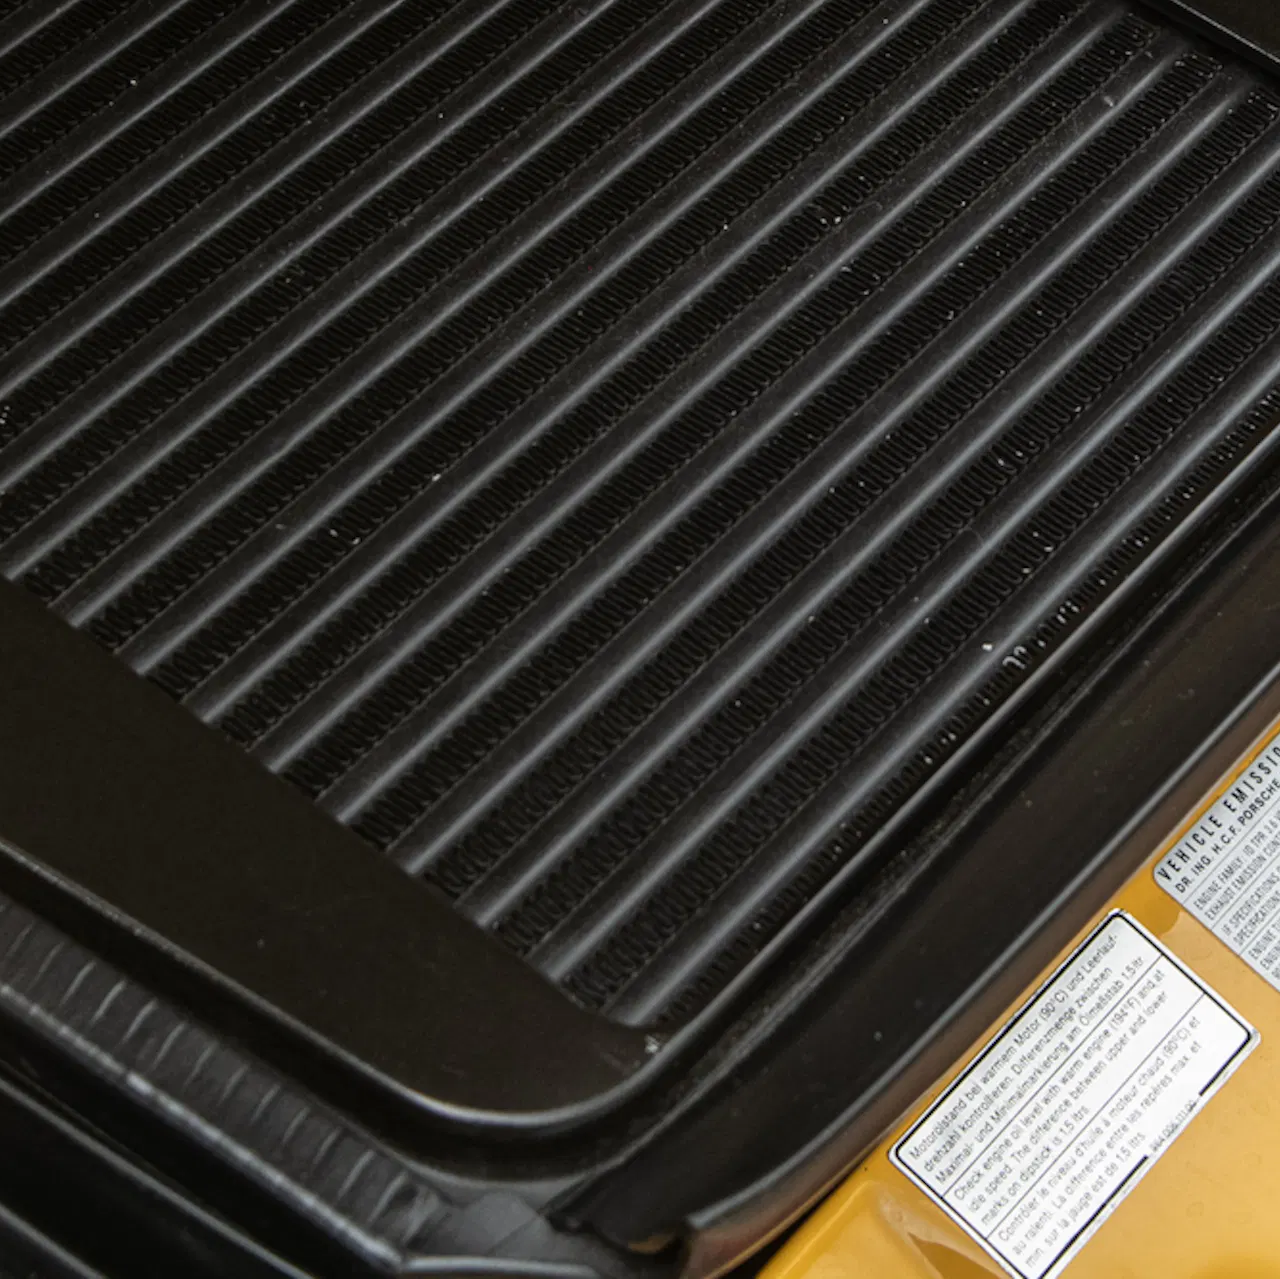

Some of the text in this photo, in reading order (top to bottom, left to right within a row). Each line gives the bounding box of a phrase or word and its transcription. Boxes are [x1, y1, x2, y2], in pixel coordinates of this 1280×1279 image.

[1156, 813, 1223, 883] VEHICLE
[1173, 871, 1195, 894] DR.
[1189, 851, 1214, 877] ING.
[1209, 822, 1241, 855] H.C.F.
[1192, 879, 1222, 910] ENGINE
[1203, 886, 1236, 921] EXHAUST
[1230, 852, 1267, 891] EMISSION
[1220, 923, 1233, 936] IF
[1227, 871, 1280, 928] SPECIFICATIONS
[1247, 929, 1276, 960] ENGINE
[962, 931, 1120, 1102] bei warmem Motor und Leerlauf-
[920, 964, 1113, 1173] drehzahl Differenzmenge zwischen
[952, 967, 1166, 1201] Check engine oil level with warm engine and at
[965, 989, 1170, 1213] idle The difference between upper and lower
[971, 1023, 1083, 1144] und Minimalmarkierung am
[1044, 1014, 1203, 1189] niveau moteur chaud et
[978, 1133, 1063, 1226] marks on dipstick is
[1010, 1040, 1204, 1255] au La entre les et
[1041, 1159, 1121, 1247] sur la jauge est de
